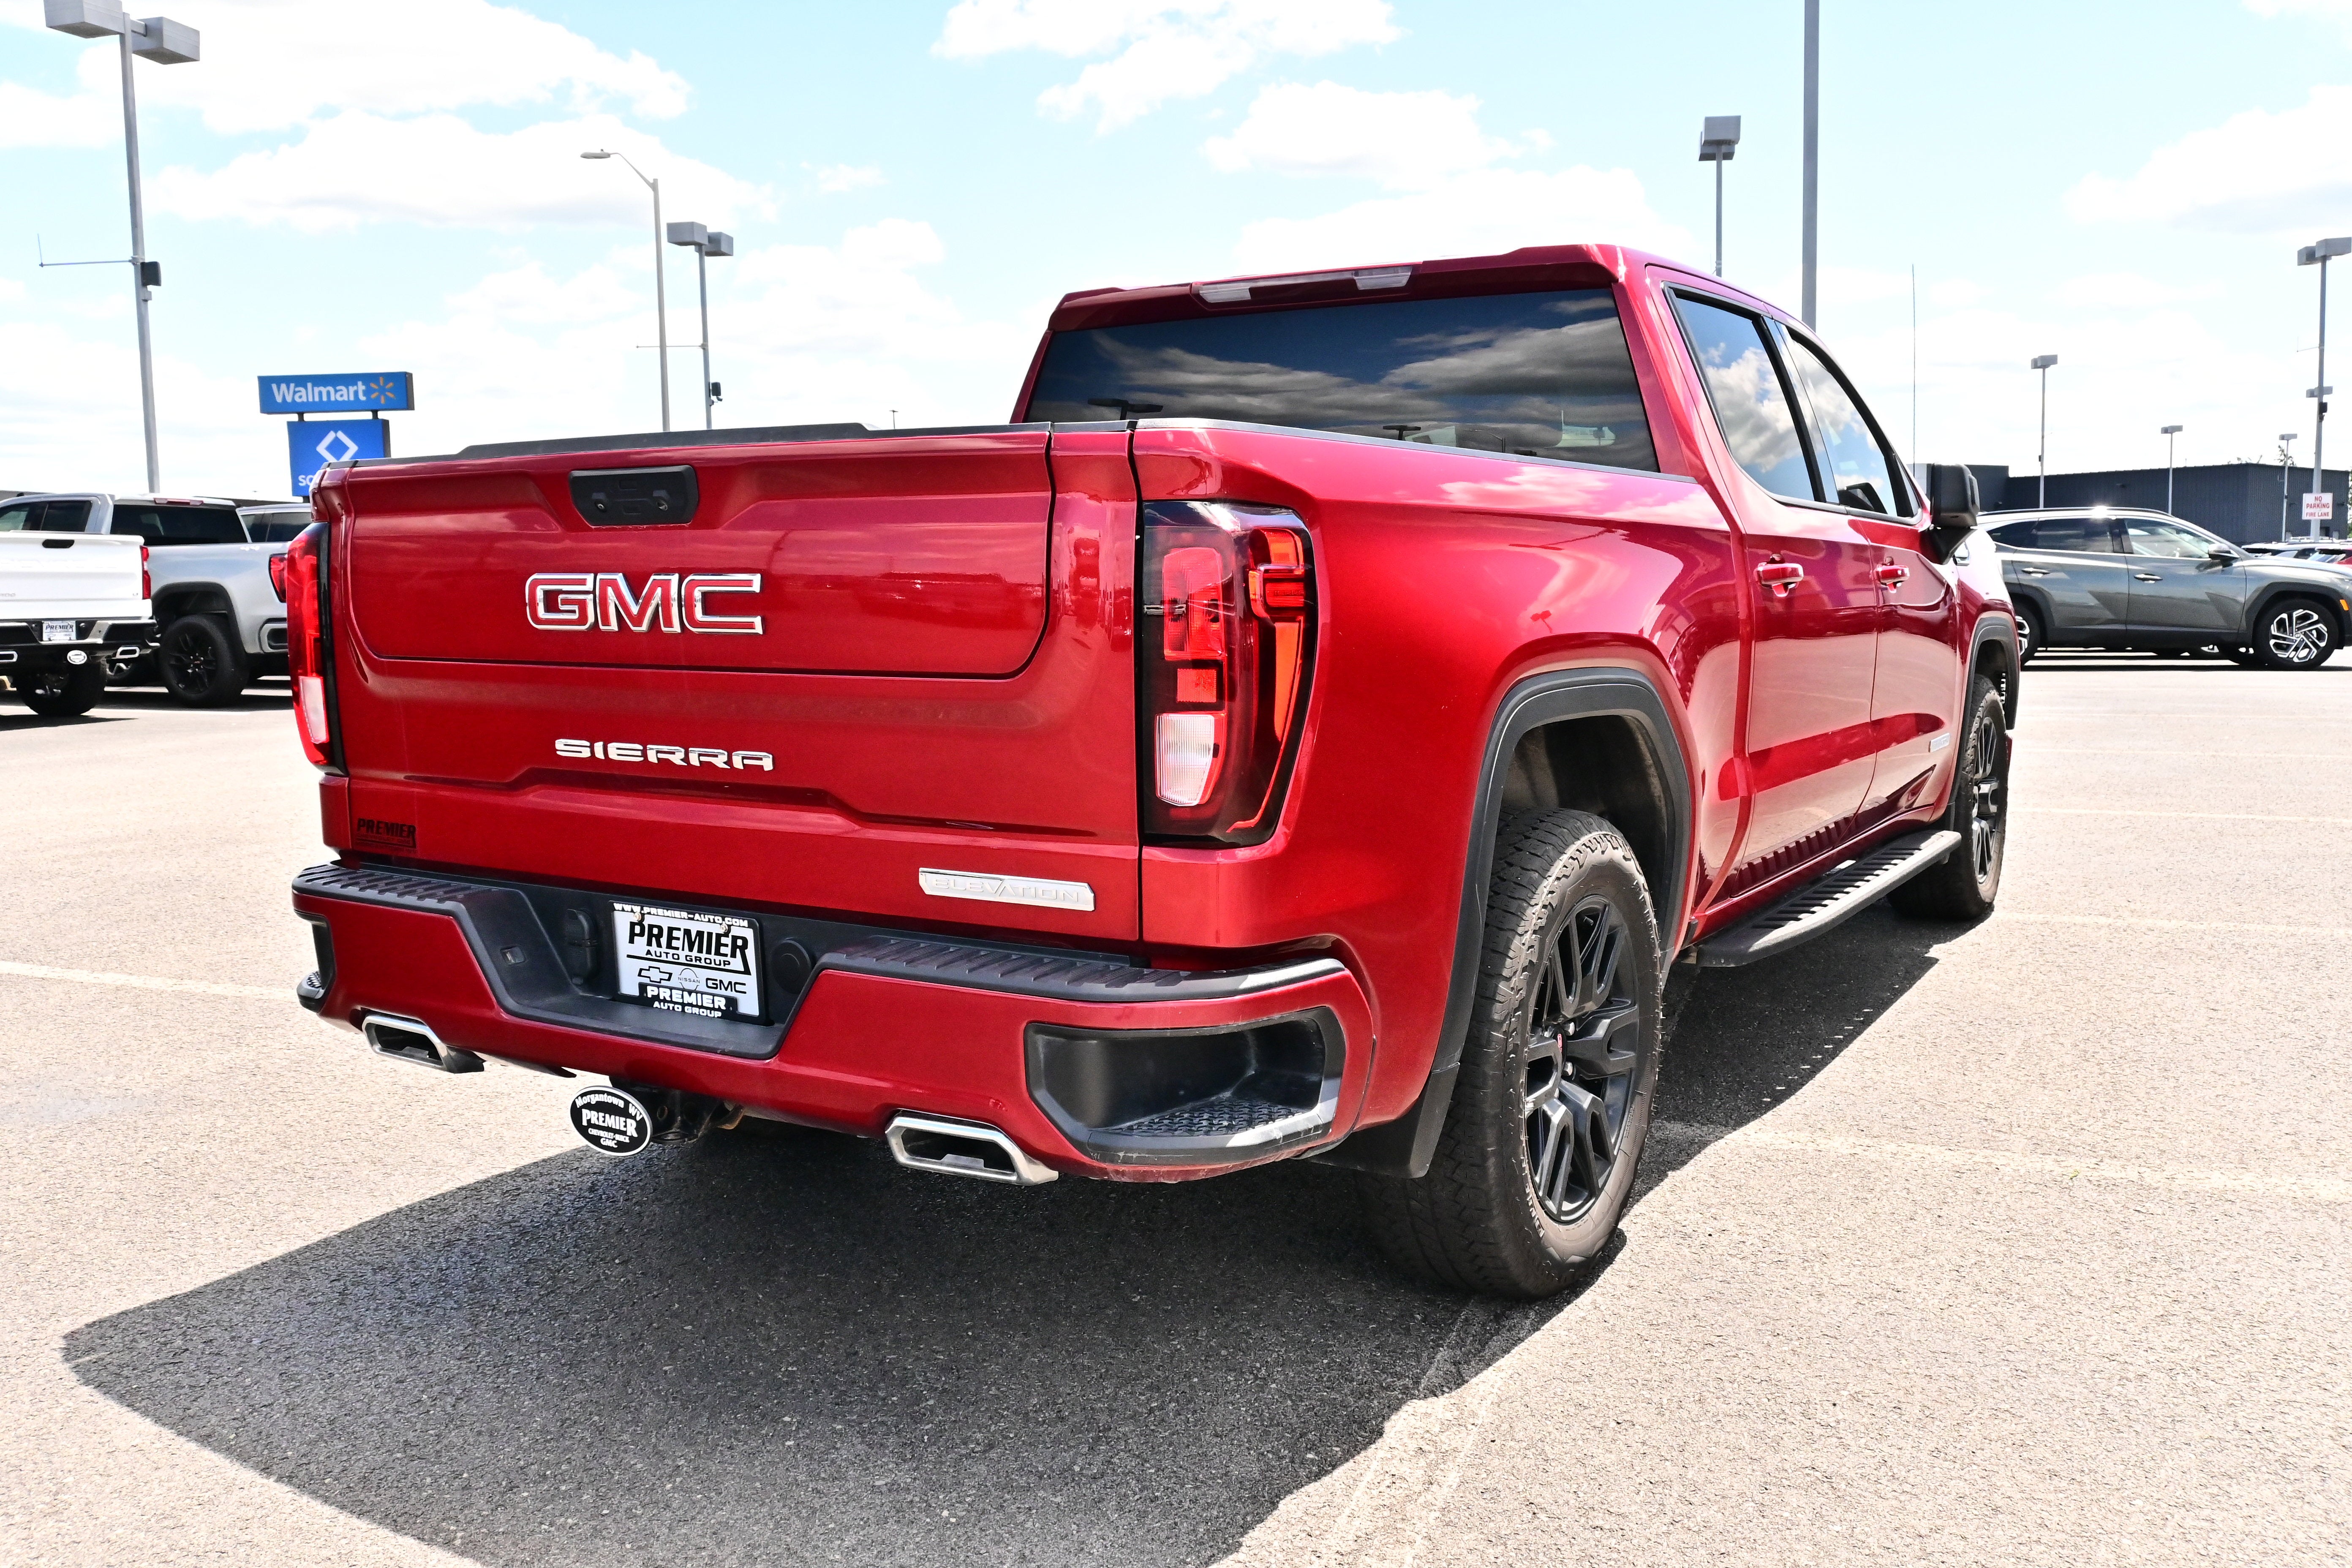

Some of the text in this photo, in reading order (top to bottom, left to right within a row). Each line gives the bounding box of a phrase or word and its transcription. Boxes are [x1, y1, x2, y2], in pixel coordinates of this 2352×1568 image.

[272, 381, 366, 403] Walmart
[525, 573, 763, 634] GMC
[555, 738, 774, 771] SIERRA
[357, 818, 416, 848] PREMIER
[934, 879, 1079, 902] ELEVATION
[628, 921, 751, 975] PREMIER
[645, 949, 731, 967] AUTO GROUP
[647, 985, 726, 1010] PREMIER
[706, 978, 746, 994] GMC
[653, 1001, 722, 1018] AUTO GROUP
[575, 1093, 643, 1121] Morgantown WV
[582, 1108, 638, 1137] PREMIER
[600, 1138, 618, 1148] GMC
